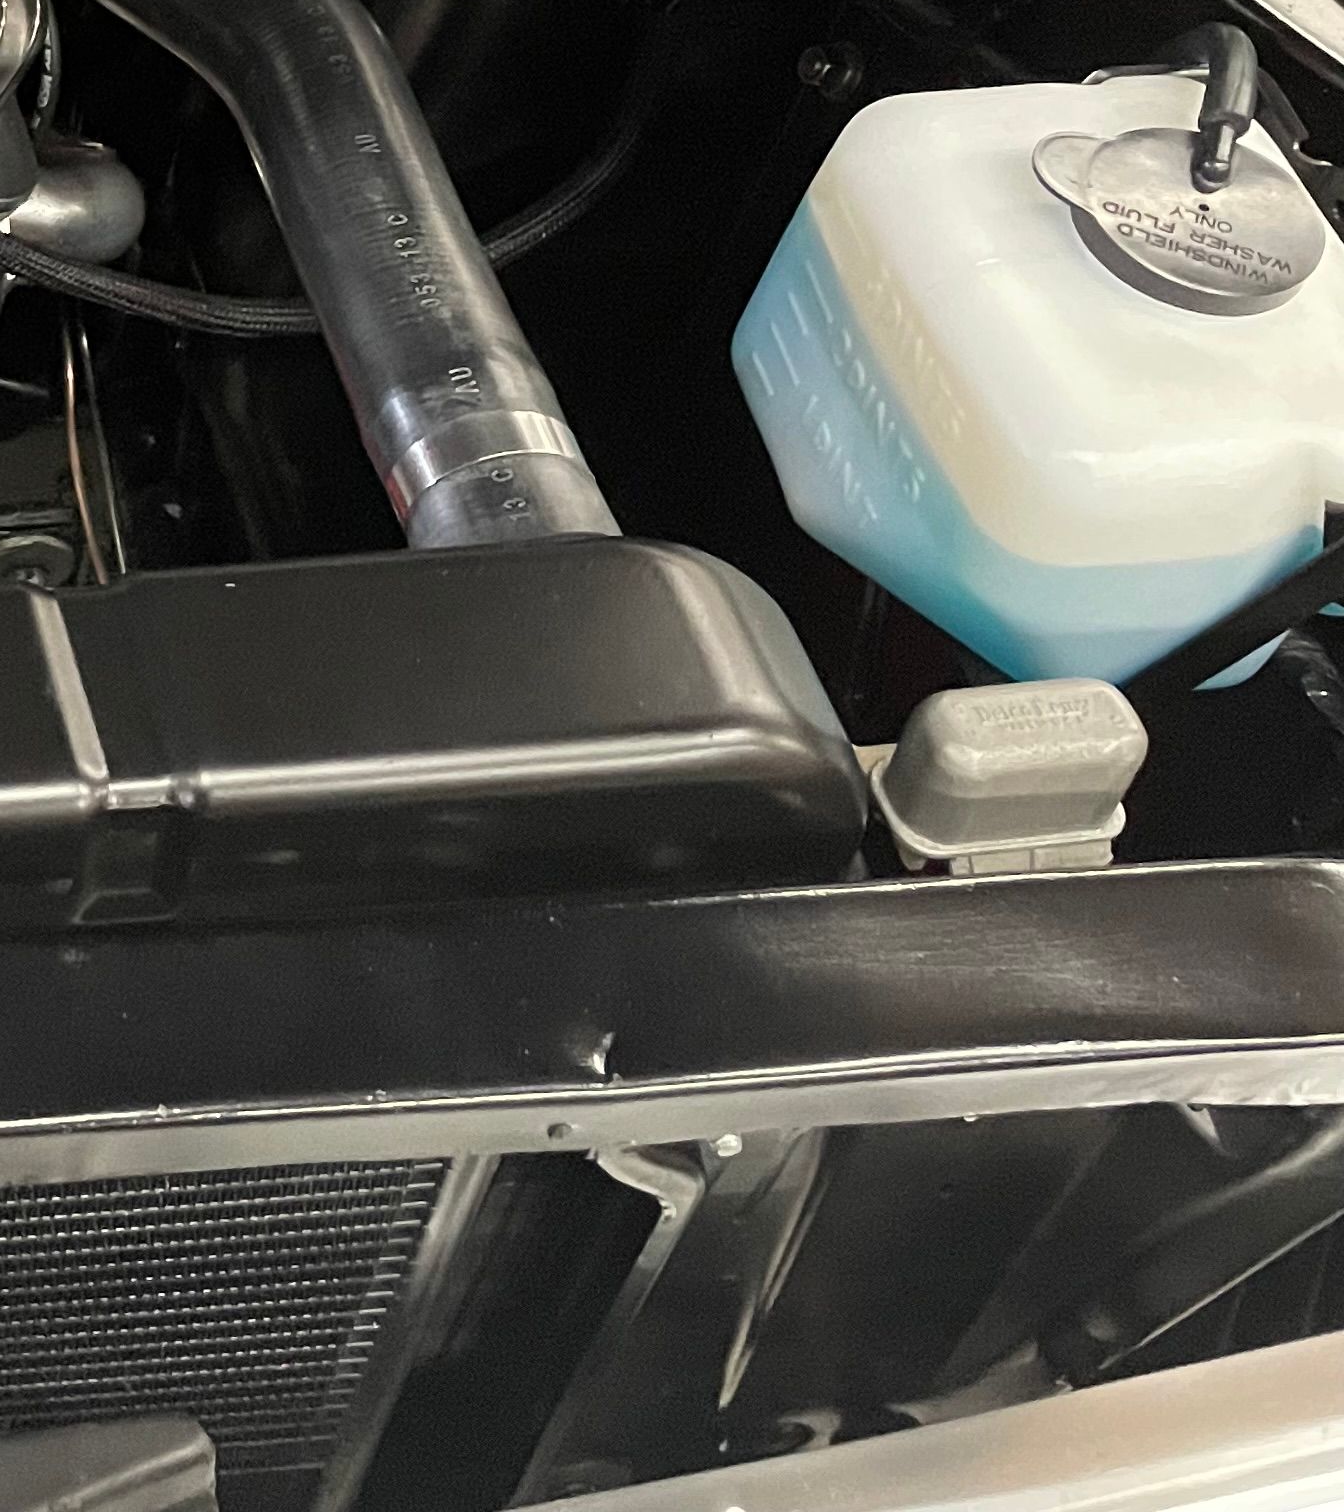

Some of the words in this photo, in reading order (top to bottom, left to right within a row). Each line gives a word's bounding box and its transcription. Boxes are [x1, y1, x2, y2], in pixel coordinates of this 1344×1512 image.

[1102, 200, 1176, 234] FLUID
[1169, 204, 1233, 234] ONLY
[1116, 222, 1269, 285] WINDSHIELD
[1189, 233, 1292, 275] WASHER
